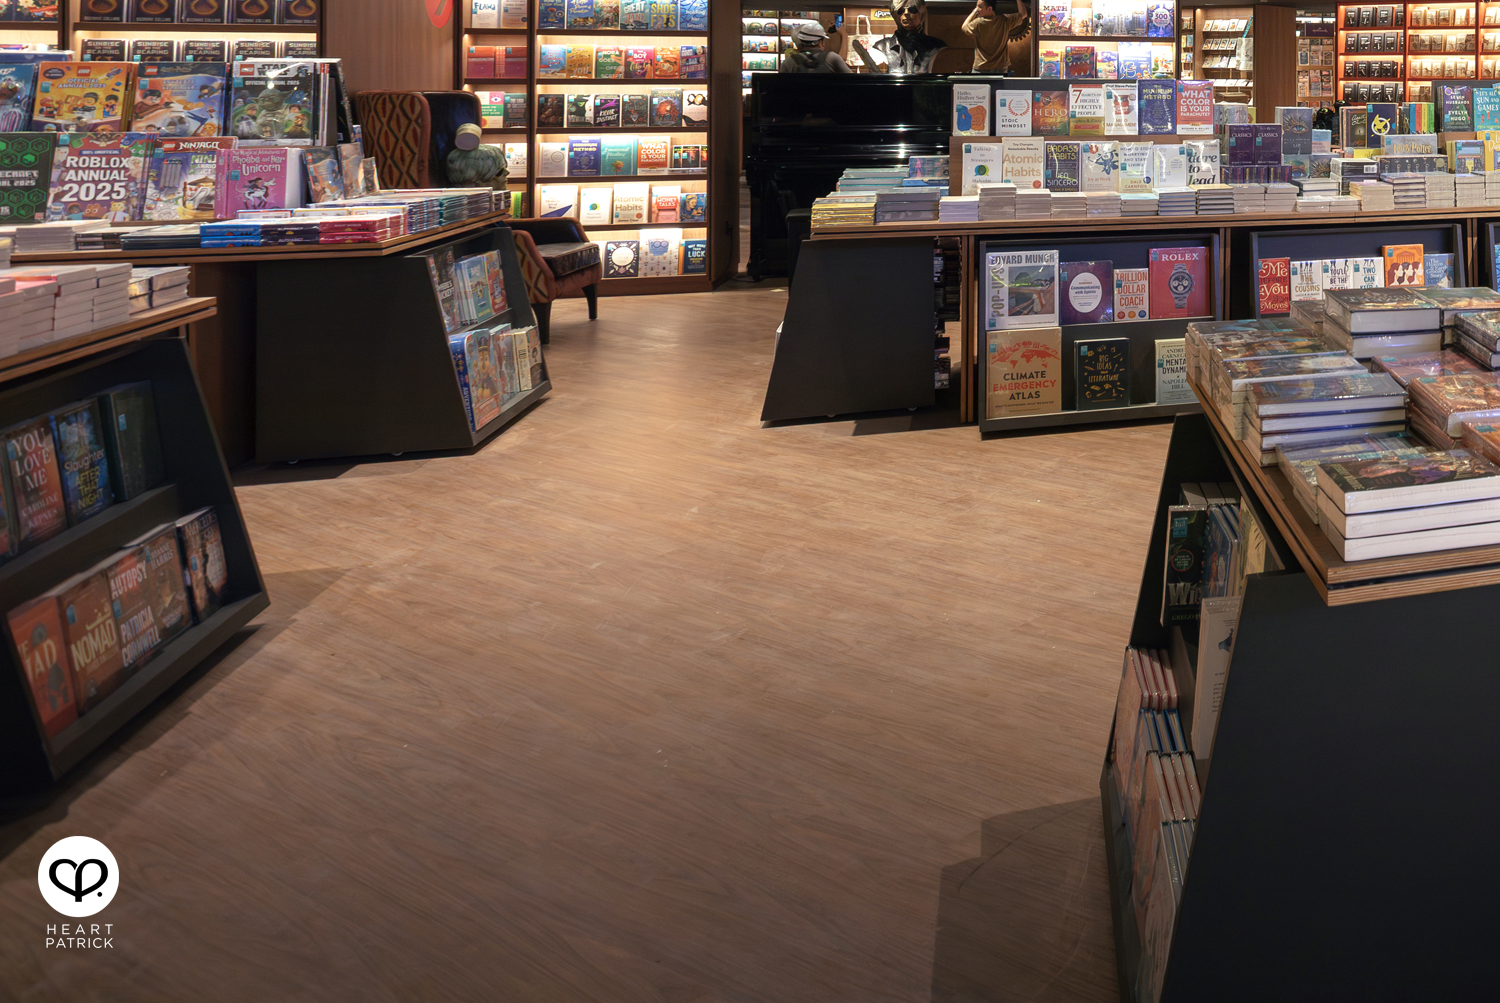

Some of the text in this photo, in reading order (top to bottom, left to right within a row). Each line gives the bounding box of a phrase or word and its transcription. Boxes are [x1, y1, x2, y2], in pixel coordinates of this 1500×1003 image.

[651, 4, 675, 14] SHOE
[66, 157, 129, 168] ROBLOX
[1003, 154, 1043, 164] Atomic
[242, 164, 280, 175] Unicorn
[1005, 167, 1041, 177] Habits
[1189, 165, 1200, 173] to
[64, 170, 128, 181] ANNUAL
[61, 183, 126, 202] 2025
[1161, 252, 1199, 262] ROLEX
[1117, 284, 1146, 295] DOLLAR
[1119, 296, 1144, 307] COACH
[1003, 370, 1046, 381] CLIMATE
[993, 379, 1057, 392] EMERGENCY
[1009, 391, 1040, 401] ATLAS
[12, 427, 46, 457] YOU
[15, 450, 51, 477] LOVE
[63, 448, 105, 476] Slaughter
[26, 468, 47, 492] ME
[110, 560, 147, 599] AUTOPSY
[120, 605, 154, 644] PATRICIA
[71, 619, 117, 672] NOMAD
